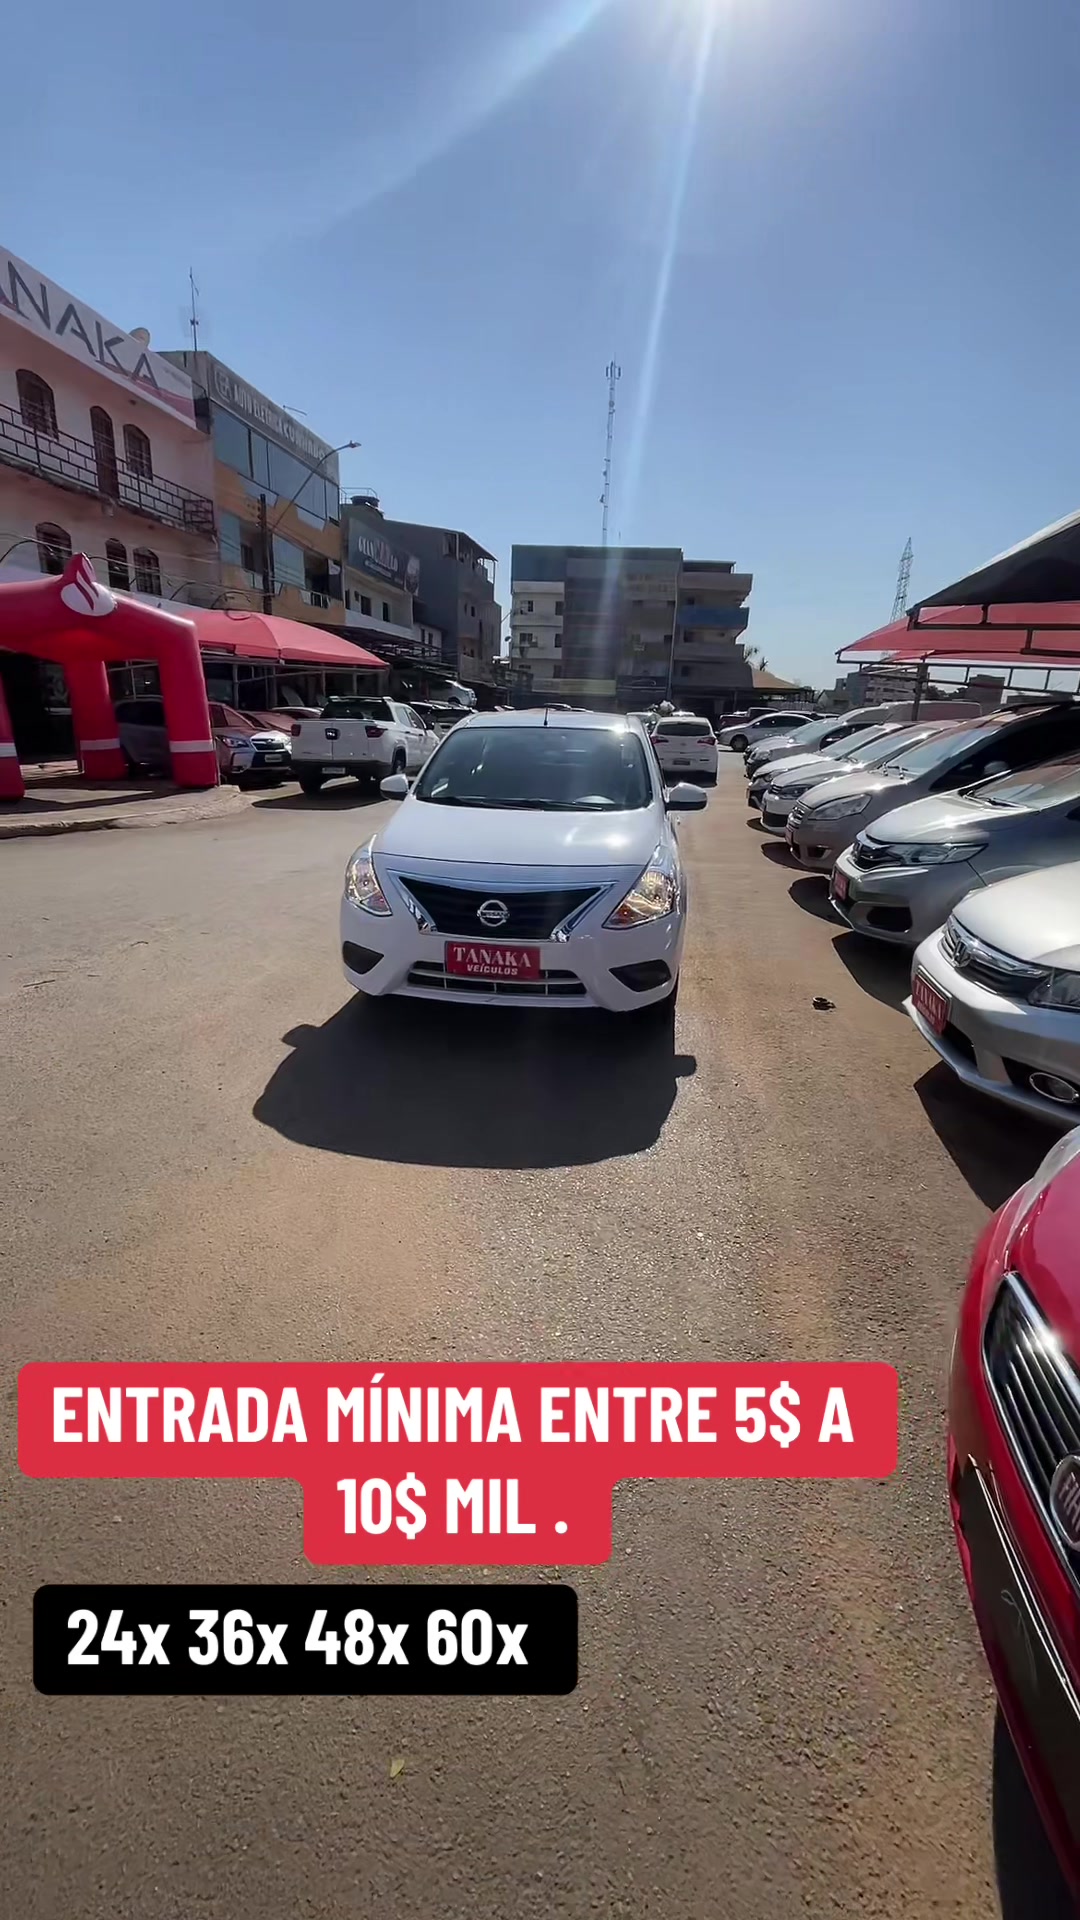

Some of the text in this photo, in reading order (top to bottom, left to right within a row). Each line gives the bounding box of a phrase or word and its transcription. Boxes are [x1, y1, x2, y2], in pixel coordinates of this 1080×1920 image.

[0, 261, 160, 390] NAKA
[453, 947, 531, 968] TANAKA
[467, 963, 519, 976] VEÍCULOS
